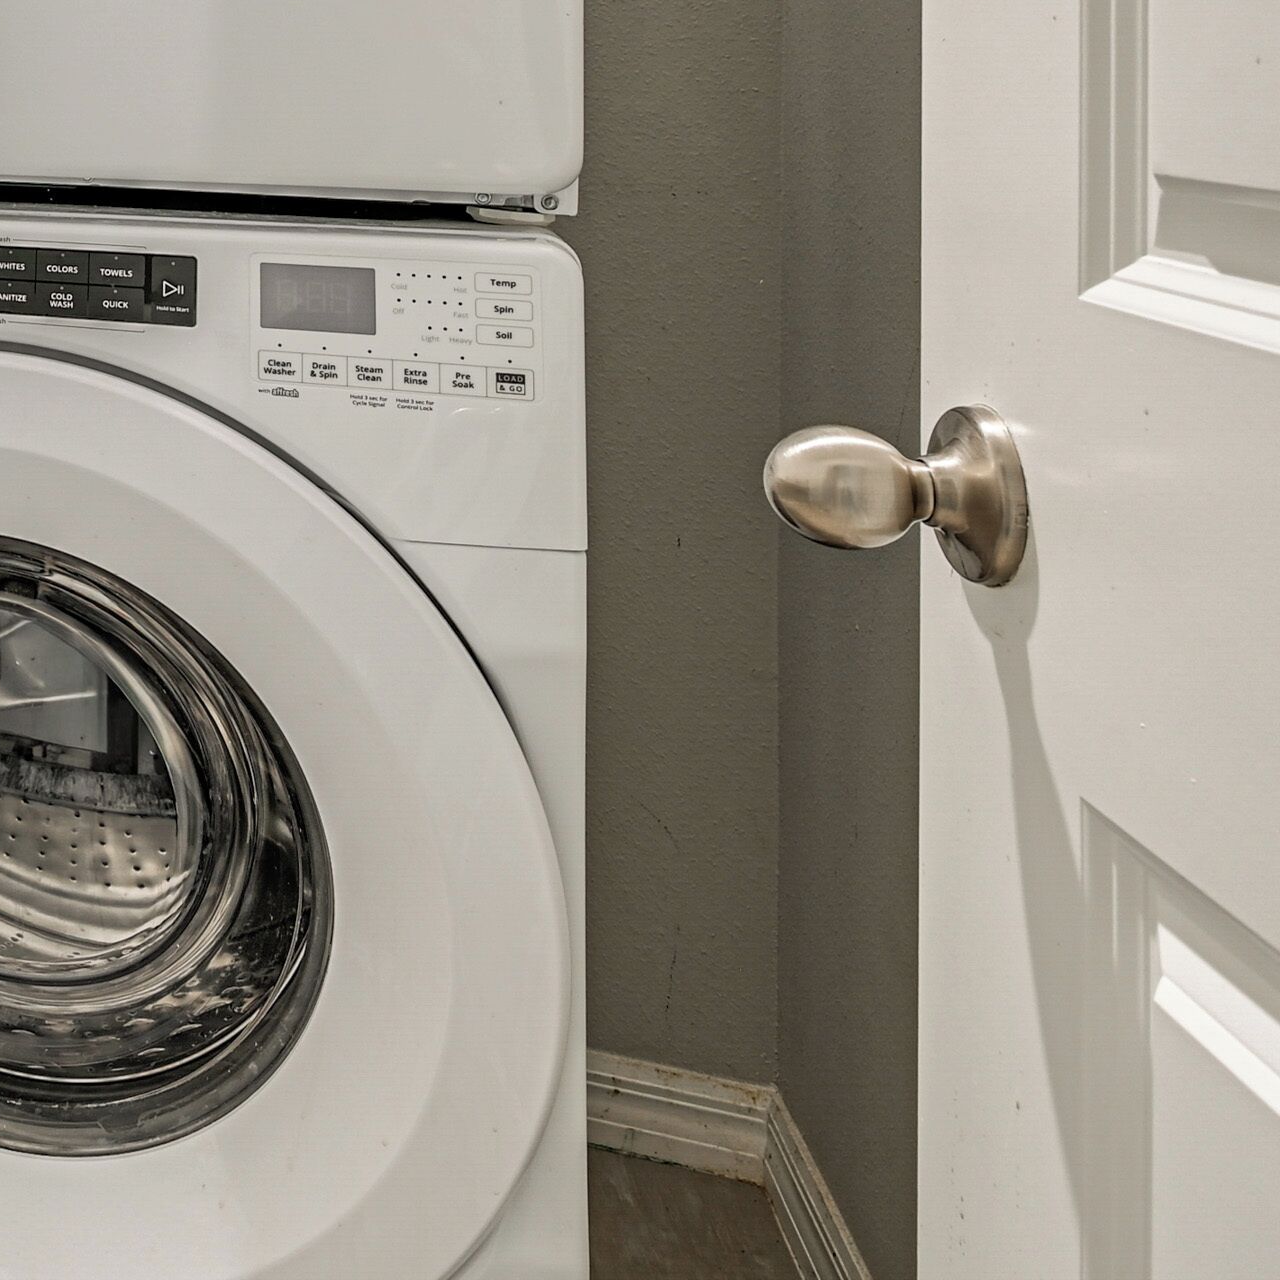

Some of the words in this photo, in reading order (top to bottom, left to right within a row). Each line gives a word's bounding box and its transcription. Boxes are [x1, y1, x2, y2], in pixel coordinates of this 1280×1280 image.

[46, 264, 79, 274] COLORS
[99, 268, 133, 278] TOWELS
[490, 278, 517, 289] Temp
[50, 292, 73, 301] COLD
[49, 300, 74, 309] WASH
[102, 299, 129, 309] QUICK
[493, 305, 514, 315] Spin
[453, 311, 469, 319] Fast
[495, 331, 513, 340] Soil
[421, 335, 440, 344] Light
[449, 337, 473, 346] Heavy
[267, 359, 292, 368] Clean
[312, 362, 336, 370] Drain
[263, 367, 296, 376] Washer
[355, 365, 384, 374] Steam
[403, 368, 427, 377] Extra
[318, 370, 338, 380] Spin
[357, 373, 382, 382] Clean
[455, 372, 471, 380] Pre
[497, 373, 524, 383] LOAD
[403, 377, 428, 386] Rinse
[452, 380, 475, 389] Soak
